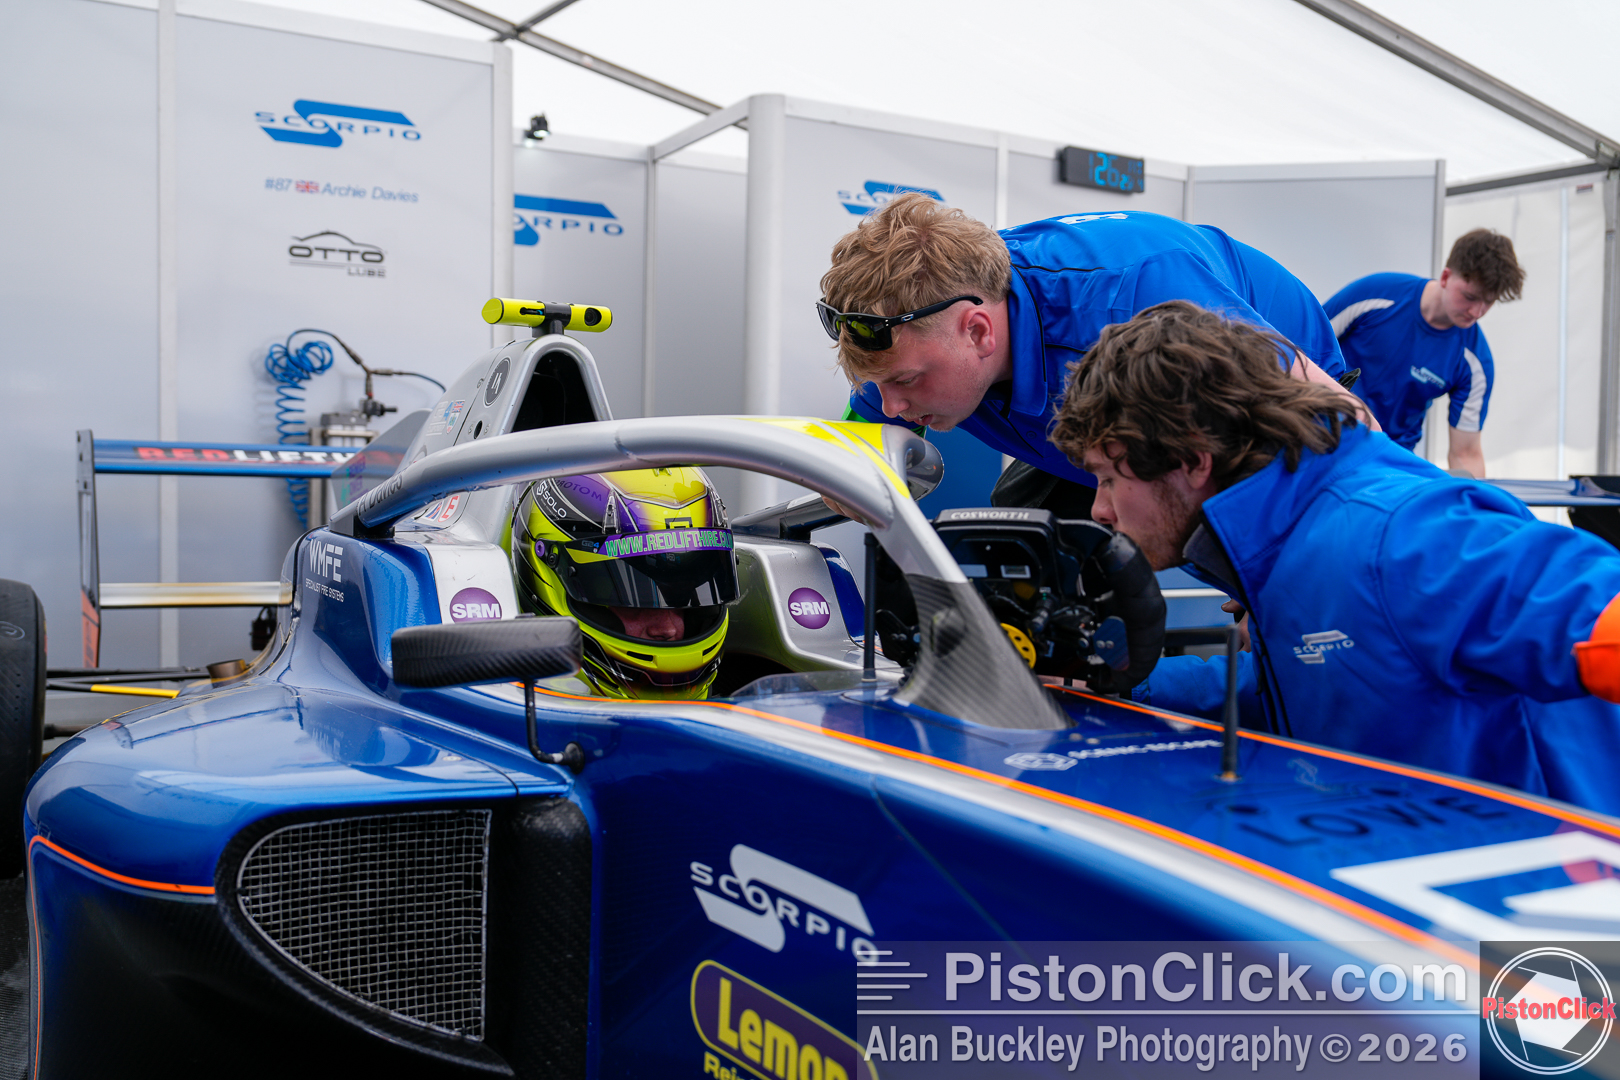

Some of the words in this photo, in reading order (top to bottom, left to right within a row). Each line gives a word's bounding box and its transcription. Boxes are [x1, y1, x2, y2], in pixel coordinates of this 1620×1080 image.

[254, 111, 422, 141] SCORPIO
[264, 177, 293, 193] #87
[321, 182, 367, 199] Archie
[371, 186, 420, 203] Davies
[288, 245, 384, 263] OTTO
[347, 266, 387, 279] LUBE
[542, 490, 567, 518] SOLO
[950, 511, 1030, 520] COSWORTH
[310, 539, 344, 583] WMFE
[452, 603, 501, 619] SRM
[790, 601, 829, 616] SRM
[1293, 639, 1355, 655] SCORPIO
[690, 861, 880, 967] SCORPIO
[703, 1051, 746, 1080] Rei
